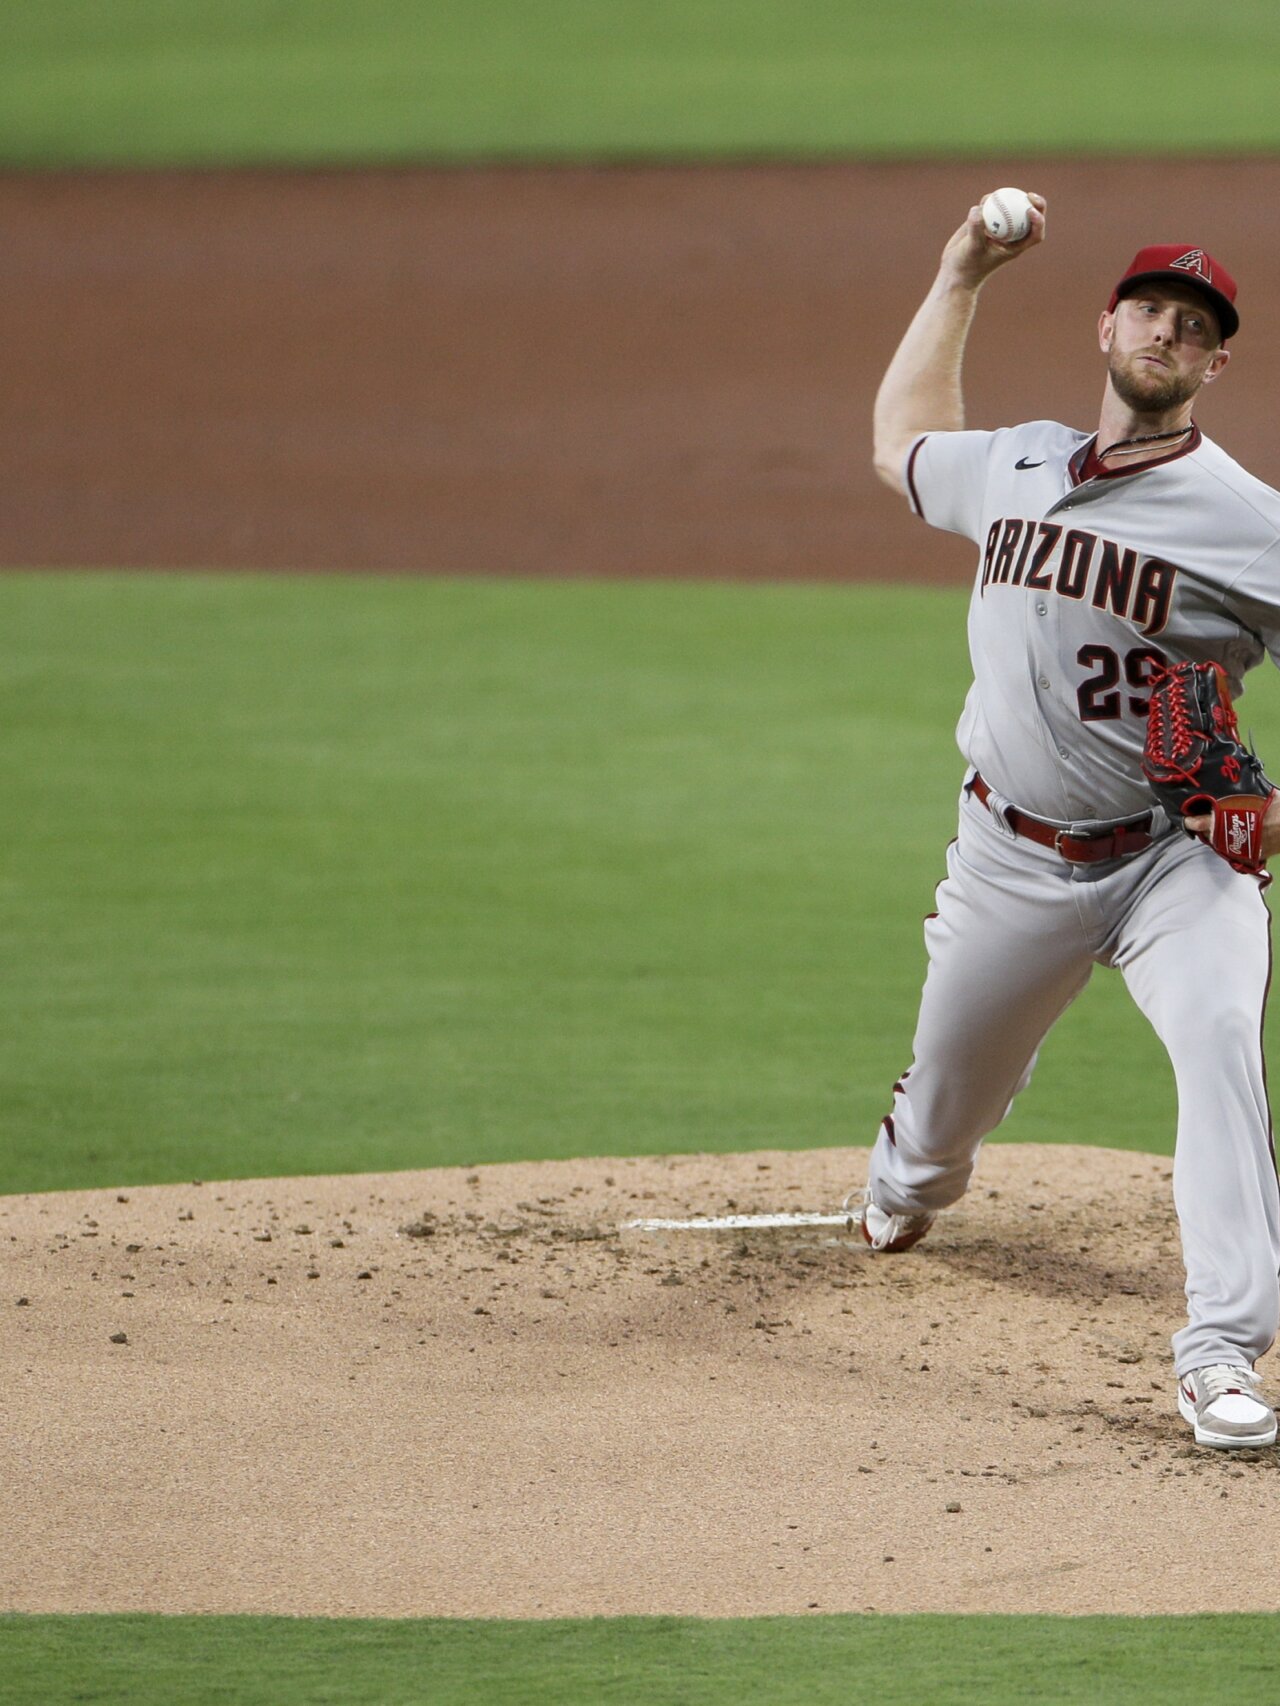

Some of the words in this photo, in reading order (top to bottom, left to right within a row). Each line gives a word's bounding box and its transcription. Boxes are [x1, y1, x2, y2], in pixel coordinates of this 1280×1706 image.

[980, 517, 1178, 637] ARIZONA
[1076, 643, 1168, 722] 29
[1228, 813, 1247, 855] Rawlings
